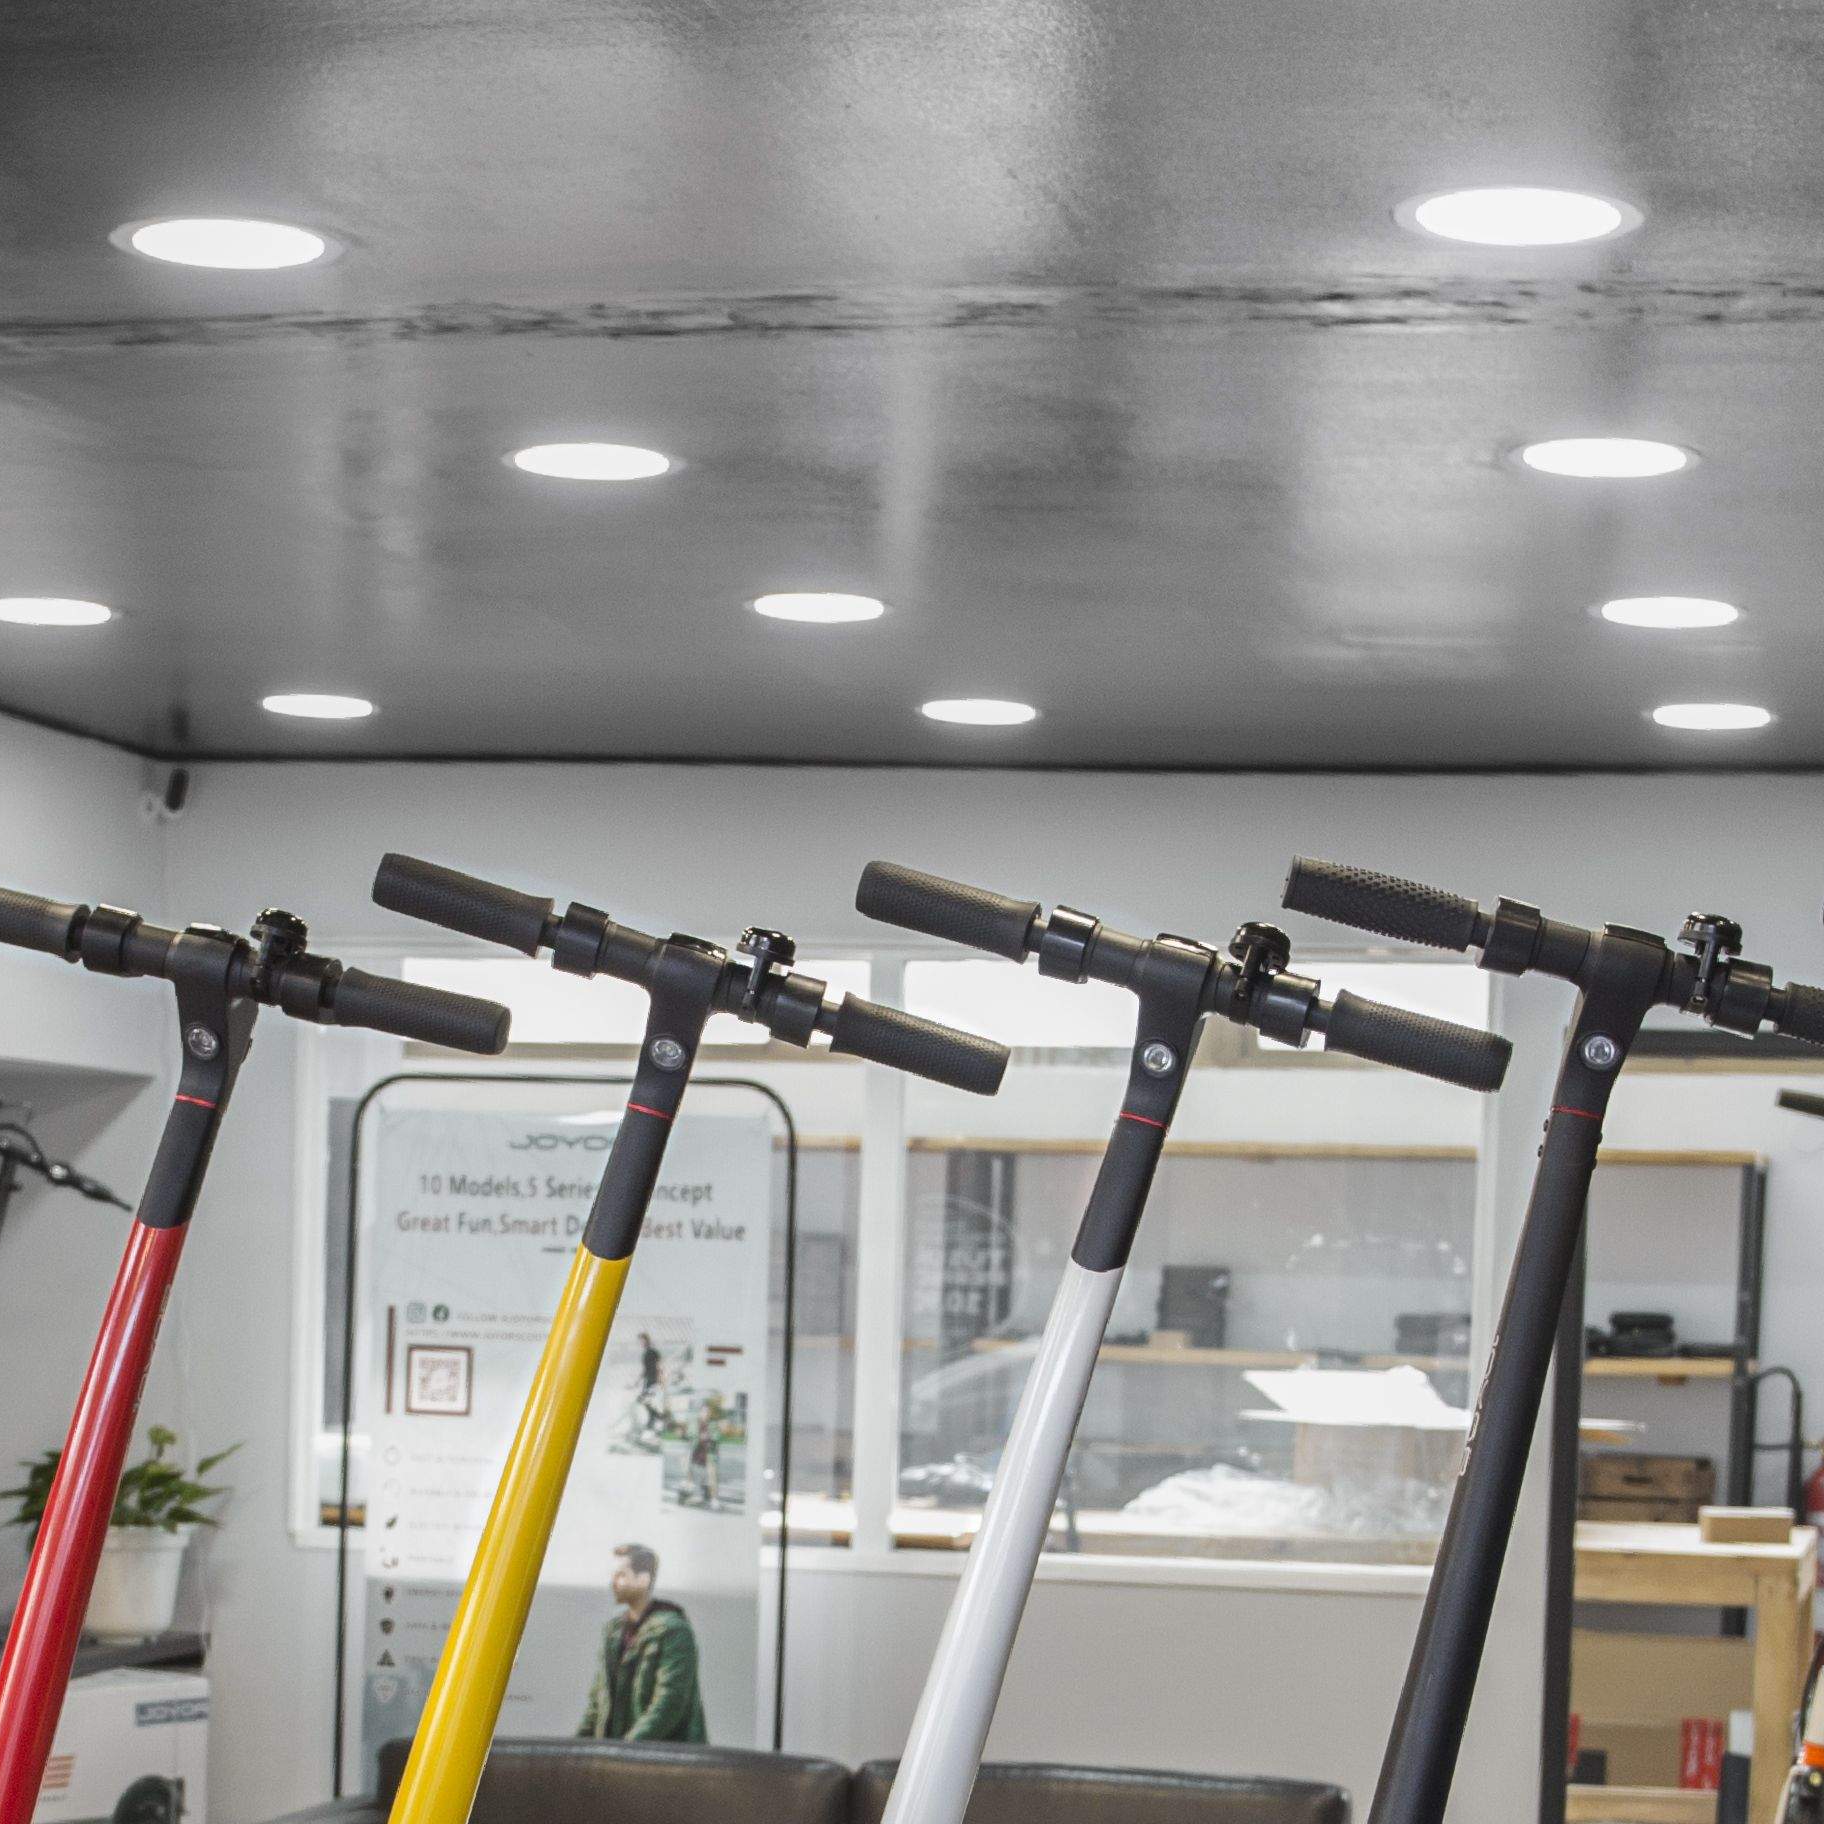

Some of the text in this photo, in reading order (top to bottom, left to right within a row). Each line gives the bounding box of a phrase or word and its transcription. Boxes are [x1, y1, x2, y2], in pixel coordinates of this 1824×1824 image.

[509, 1133, 614, 1150] JOYO
[420, 1175, 442, 1196] 10
[396, 1211, 451, 1233] Great
[691, 1218, 747, 1242] Value
